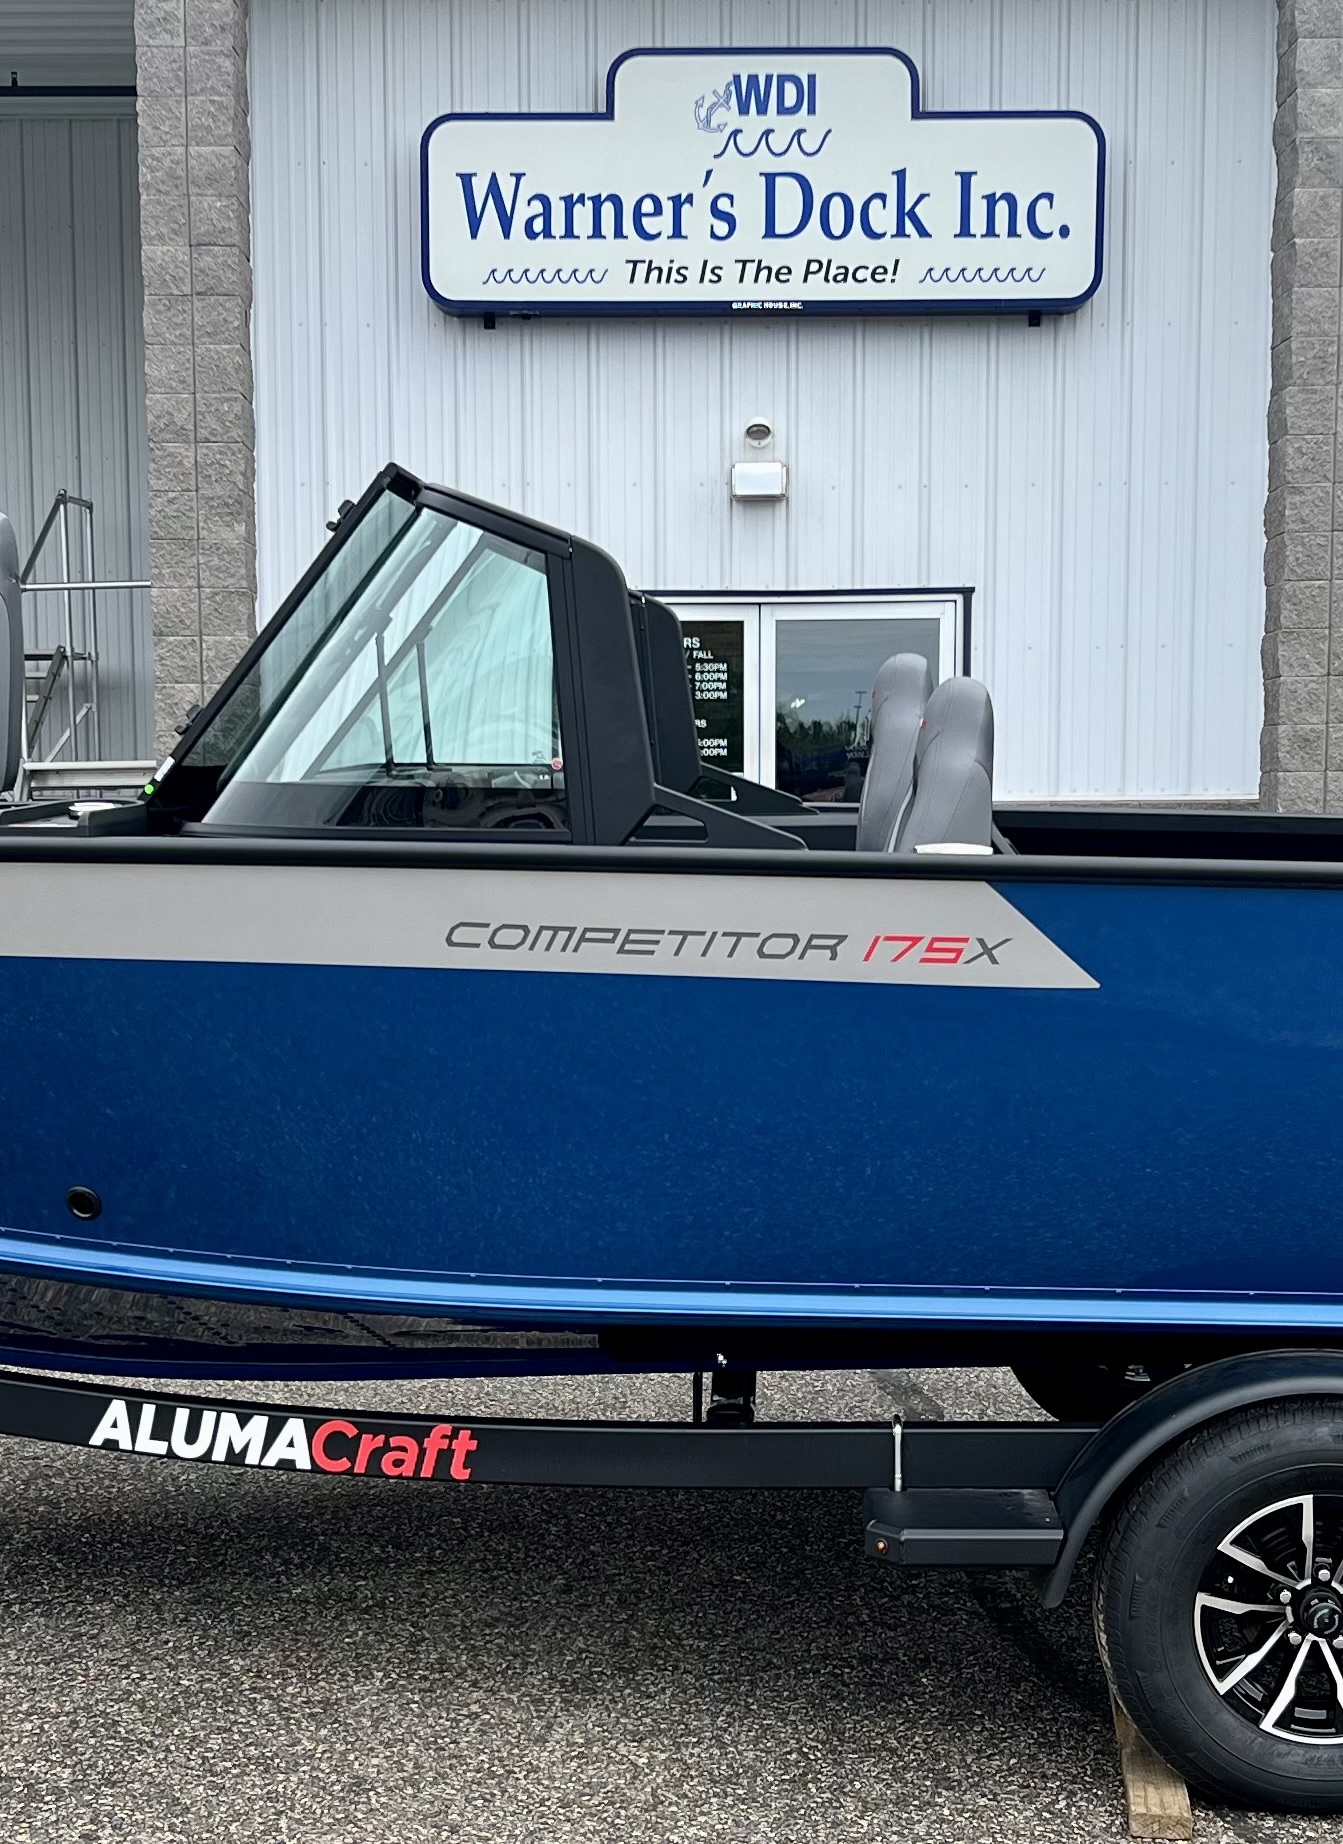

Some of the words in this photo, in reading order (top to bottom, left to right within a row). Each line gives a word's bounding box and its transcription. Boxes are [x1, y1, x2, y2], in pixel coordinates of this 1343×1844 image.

[733, 73, 816, 117] WDI
[456, 168, 737, 242] Warner's
[759, 168, 932, 242] Dock
[954, 170, 1070, 241] Inc.
[625, 259, 688, 285] This
[699, 259, 724, 285] Is
[734, 259, 793, 285] The
[802, 259, 900, 285] Place!
[692, 650, 714, 660] FALL
[445, 922, 848, 962] COMPETITOR
[862, 935, 1012, 965] 175X
[89, 1399, 477, 1482] ALUMACraft
